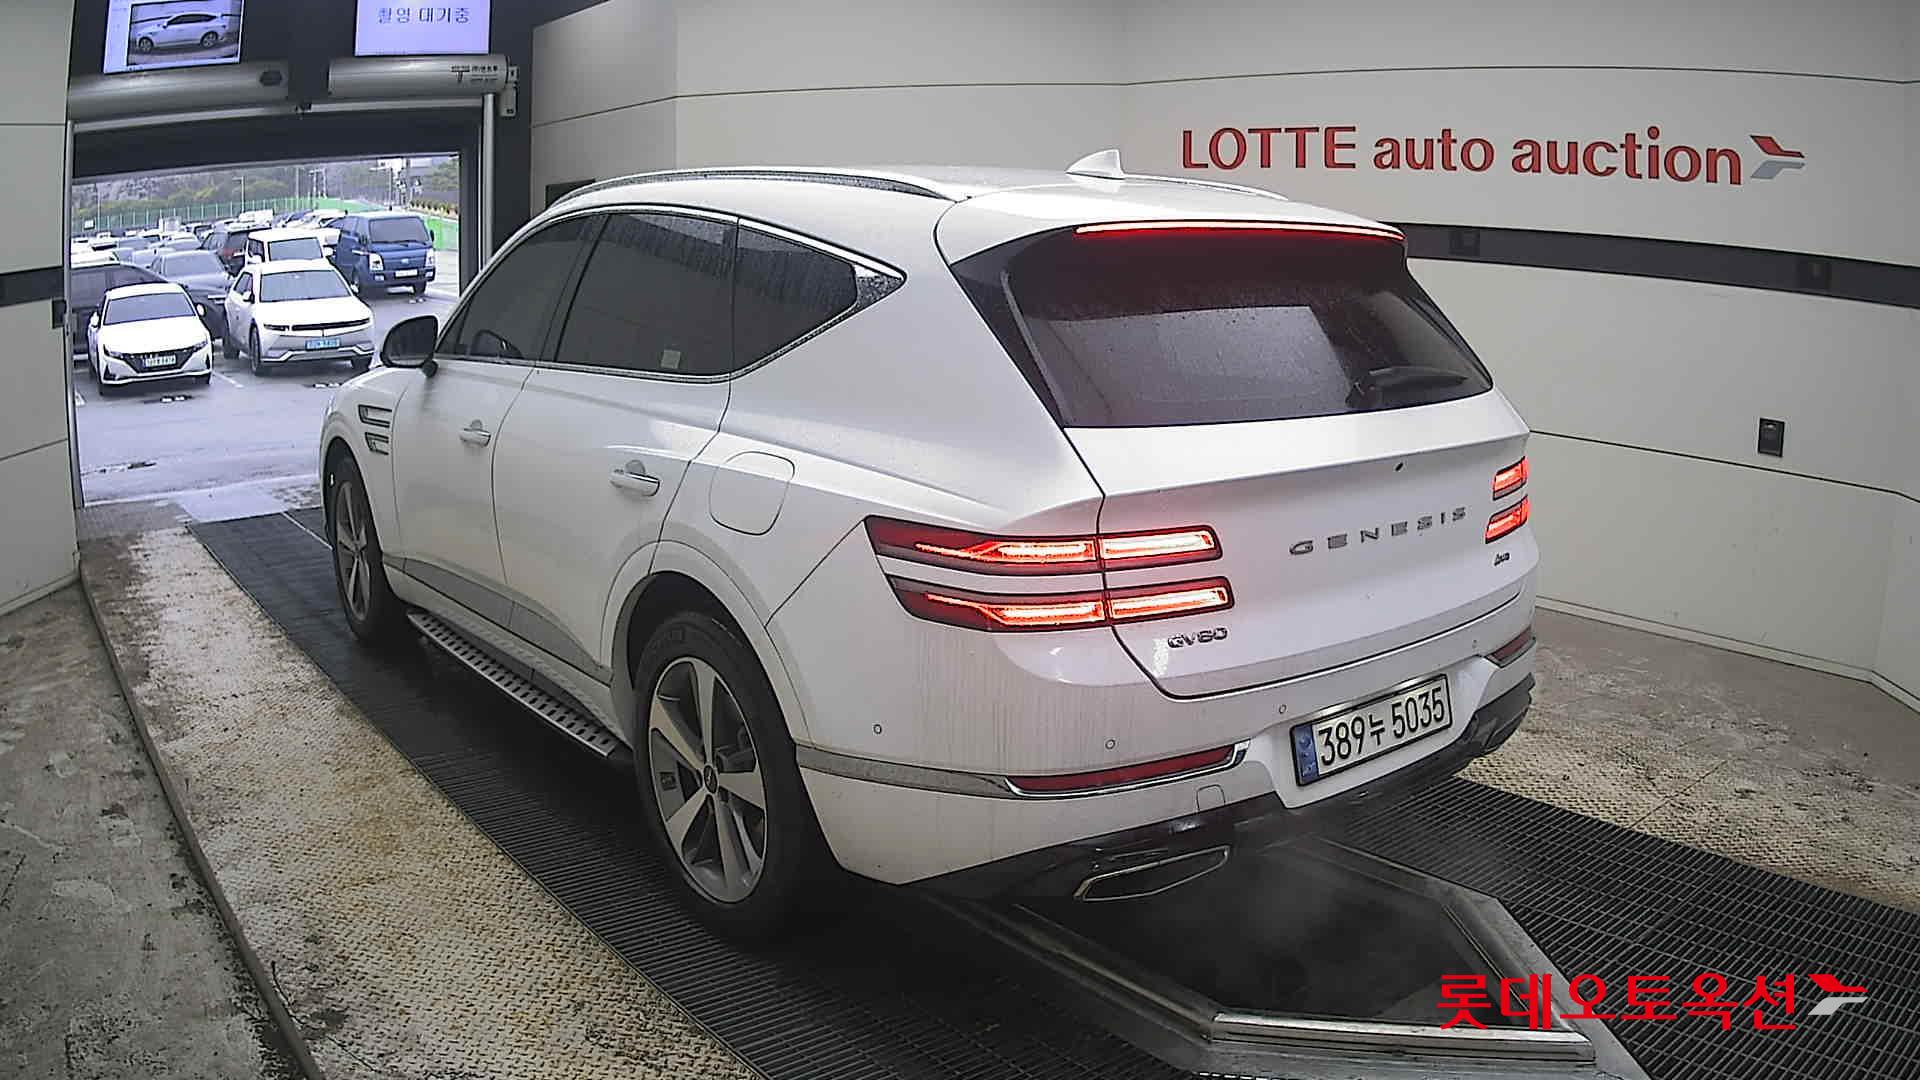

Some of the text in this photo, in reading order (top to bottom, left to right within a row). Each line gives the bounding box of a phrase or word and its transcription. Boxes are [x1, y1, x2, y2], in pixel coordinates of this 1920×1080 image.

[419, 7, 470, 23] 대기중
[1182, 125, 1742, 185] LOTTE auto auction
[1289, 506, 1466, 555] GENESIS
[1167, 627, 1228, 648] GV80
[1318, 685, 1446, 766] 389누 5035
